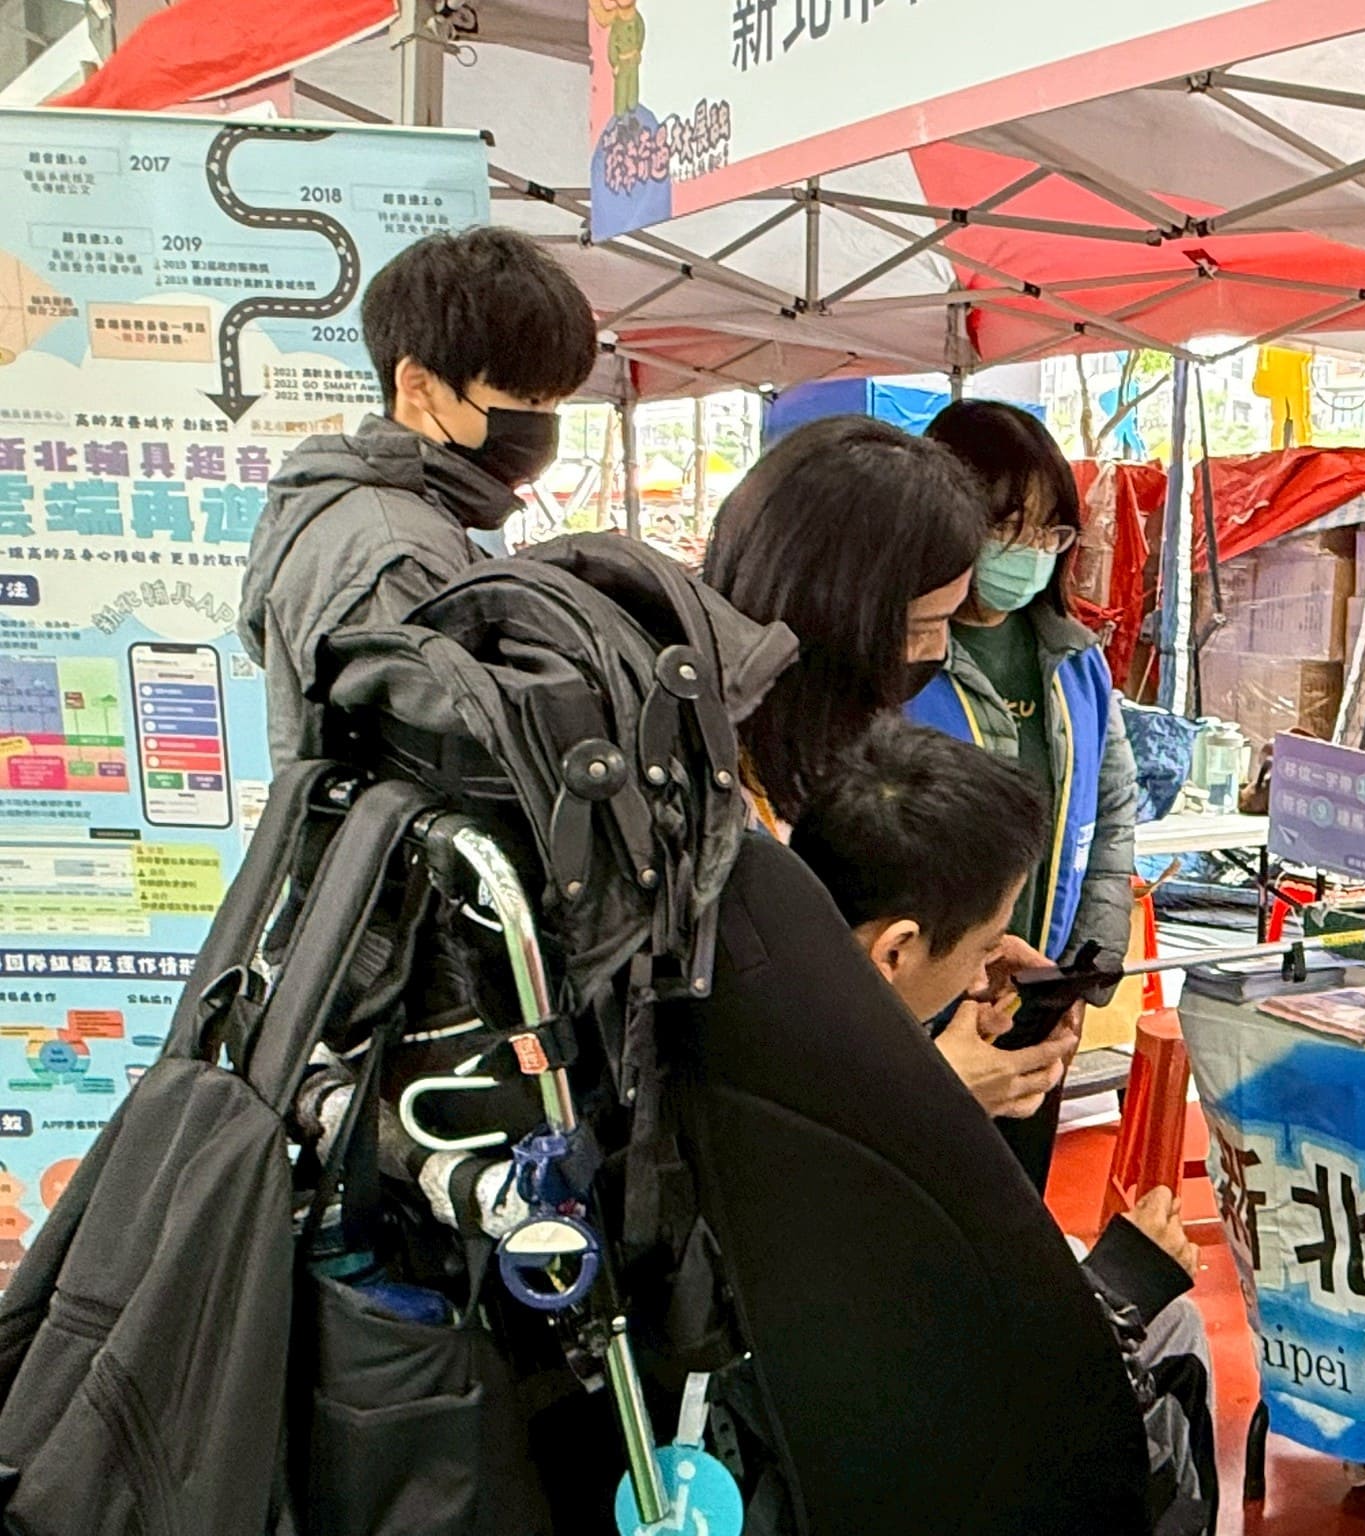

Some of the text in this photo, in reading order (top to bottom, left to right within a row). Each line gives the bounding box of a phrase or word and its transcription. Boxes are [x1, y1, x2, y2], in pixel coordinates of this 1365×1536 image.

[130, 155, 170, 172] 2017
[300, 186, 342, 204] 2018
[162, 235, 202, 252] 2019
[311, 327, 359, 343] 2020
[302, 381, 319, 390] GO
[323, 381, 358, 391] SMART
